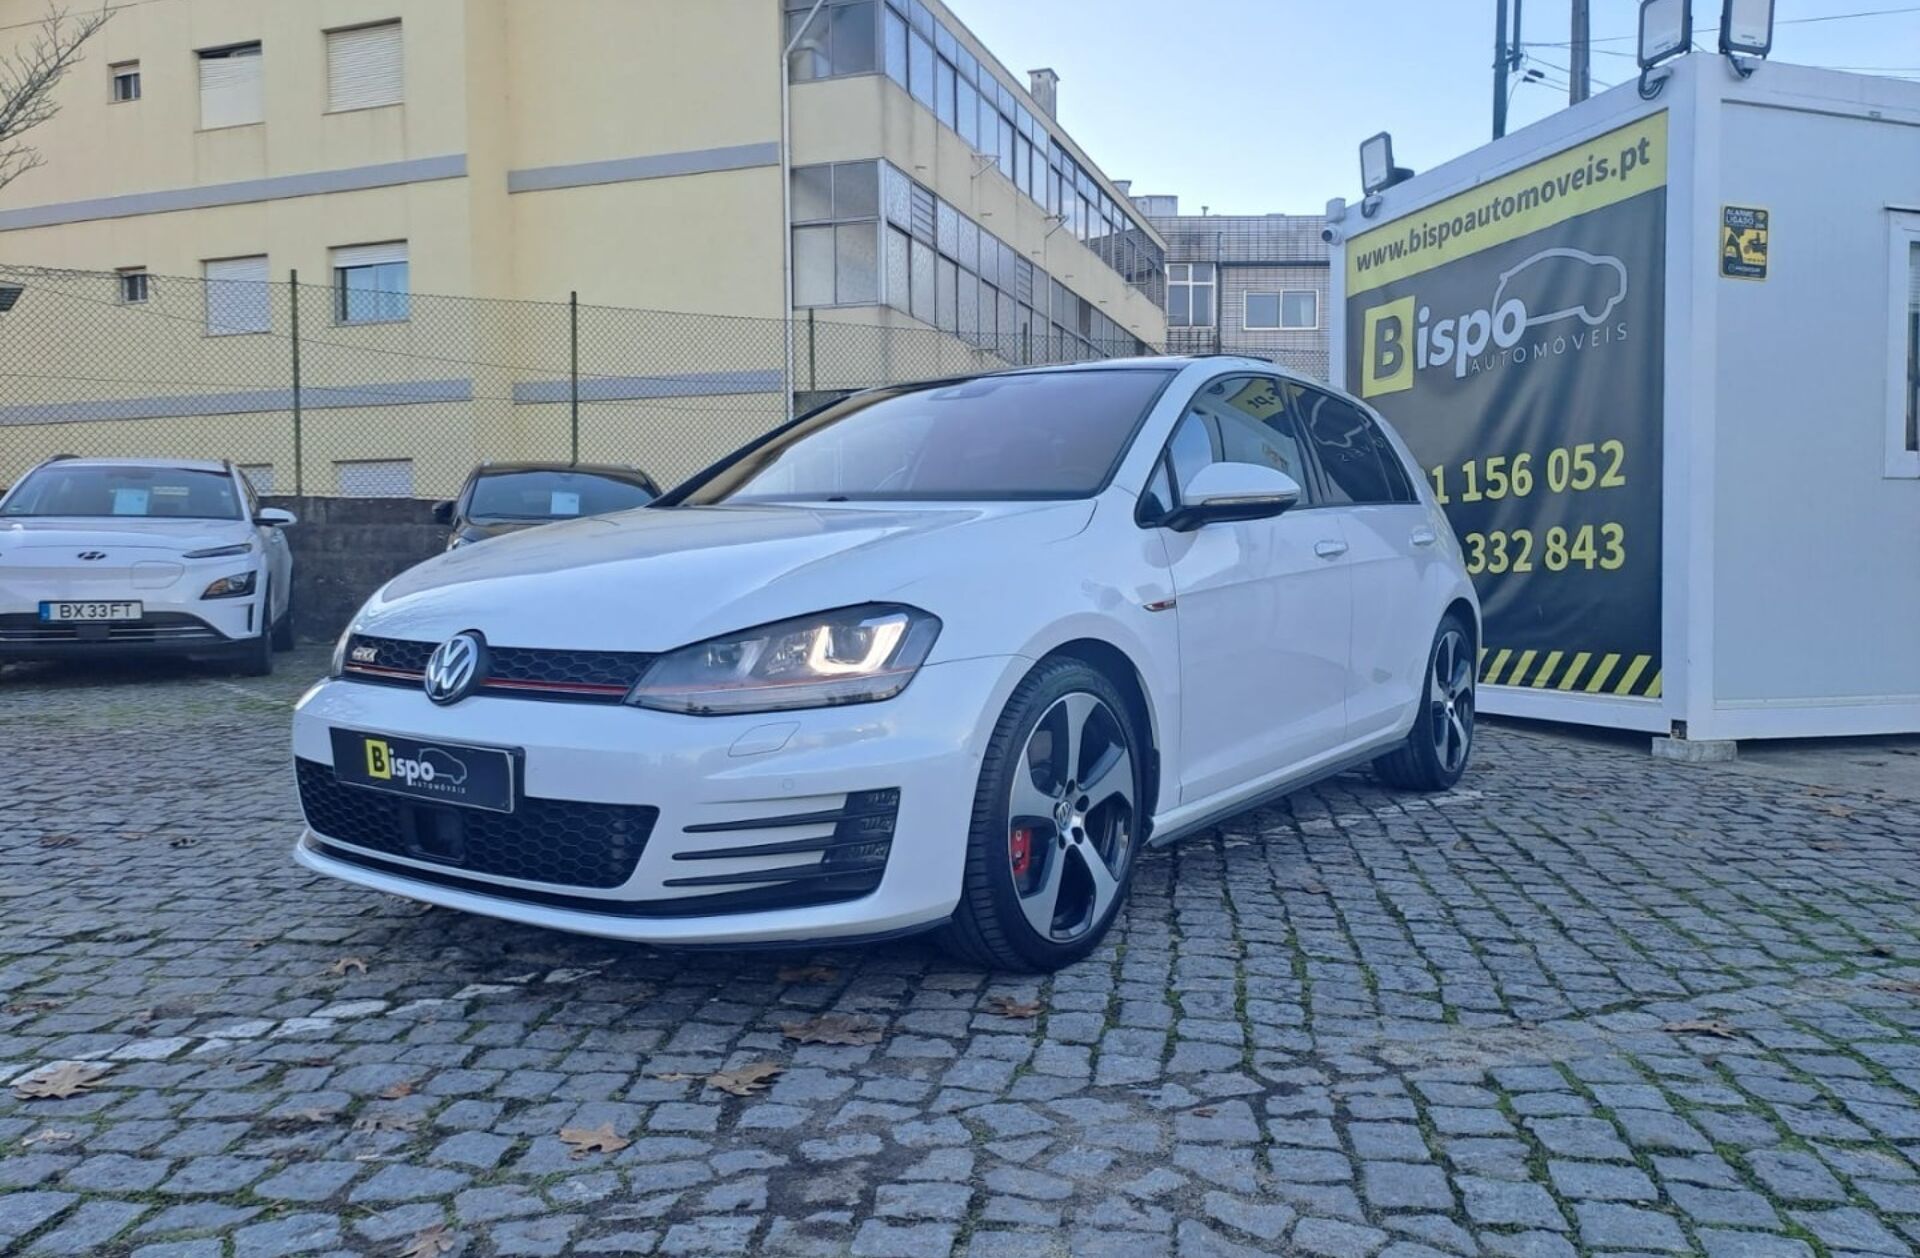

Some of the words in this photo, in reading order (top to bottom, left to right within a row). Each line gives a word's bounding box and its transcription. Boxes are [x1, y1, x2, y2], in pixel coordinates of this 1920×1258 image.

[1356, 136, 1650, 273] www.bispoautomoveis.pt
[1373, 298, 1527, 381] Bispo
[1462, 453, 1533, 502] 156
[1547, 440, 1625, 492] 052
[1465, 529, 1533, 574] 332
[1545, 522, 1626, 571] 843
[372, 746, 434, 786] Bispo
